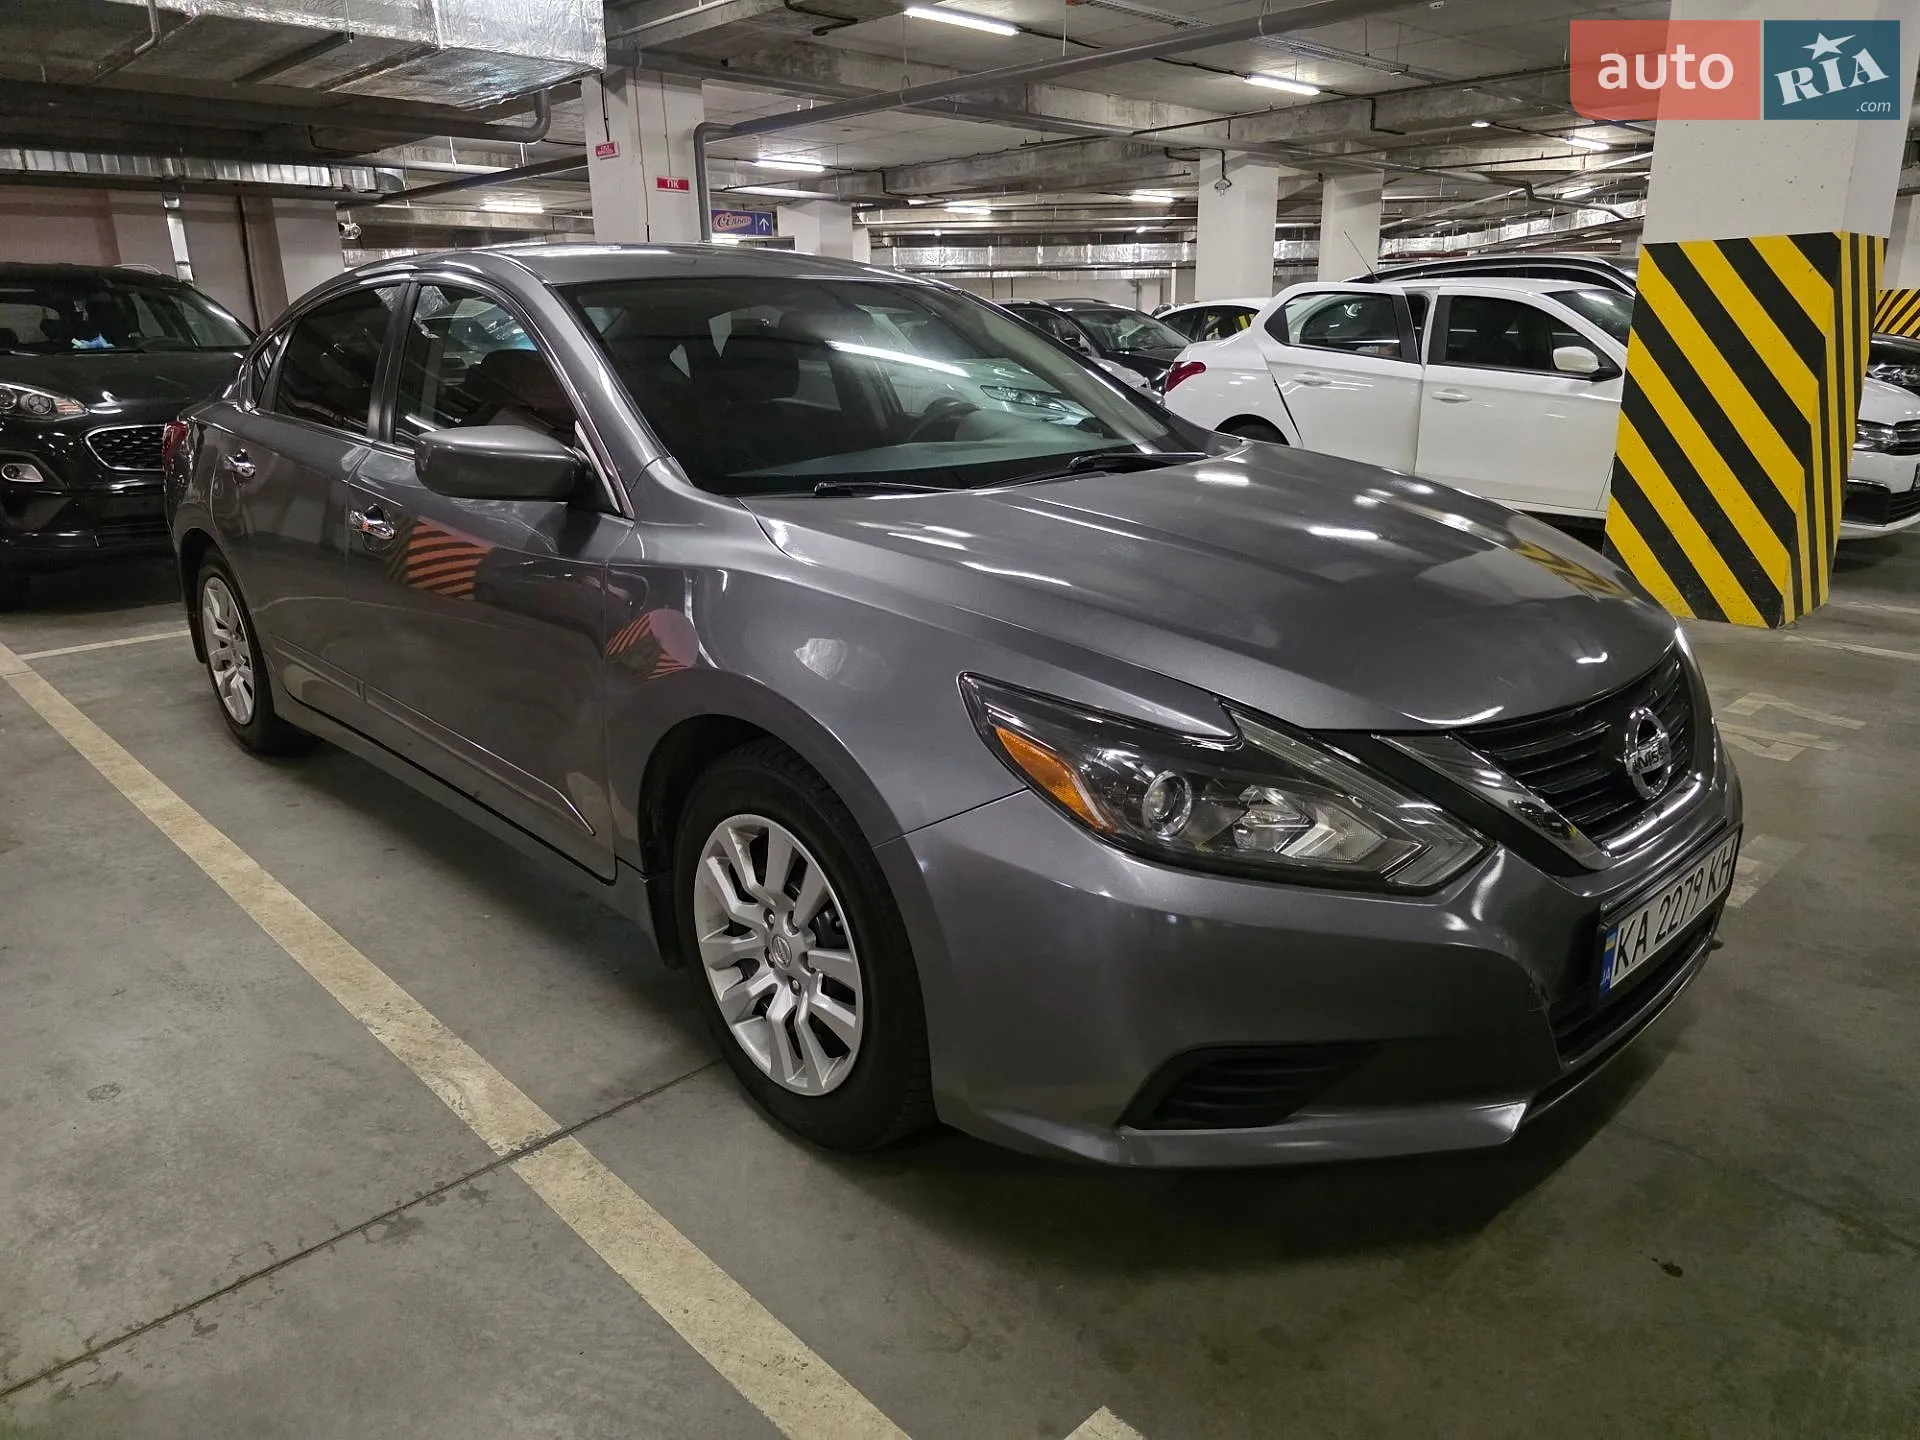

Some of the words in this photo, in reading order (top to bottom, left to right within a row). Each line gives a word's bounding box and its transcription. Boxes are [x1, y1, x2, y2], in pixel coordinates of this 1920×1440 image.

[1633, 743, 1668, 771] NISS
[1614, 909, 1649, 976] KA
[1654, 867, 1705, 945] 2279
[1705, 838, 1735, 900] KH
